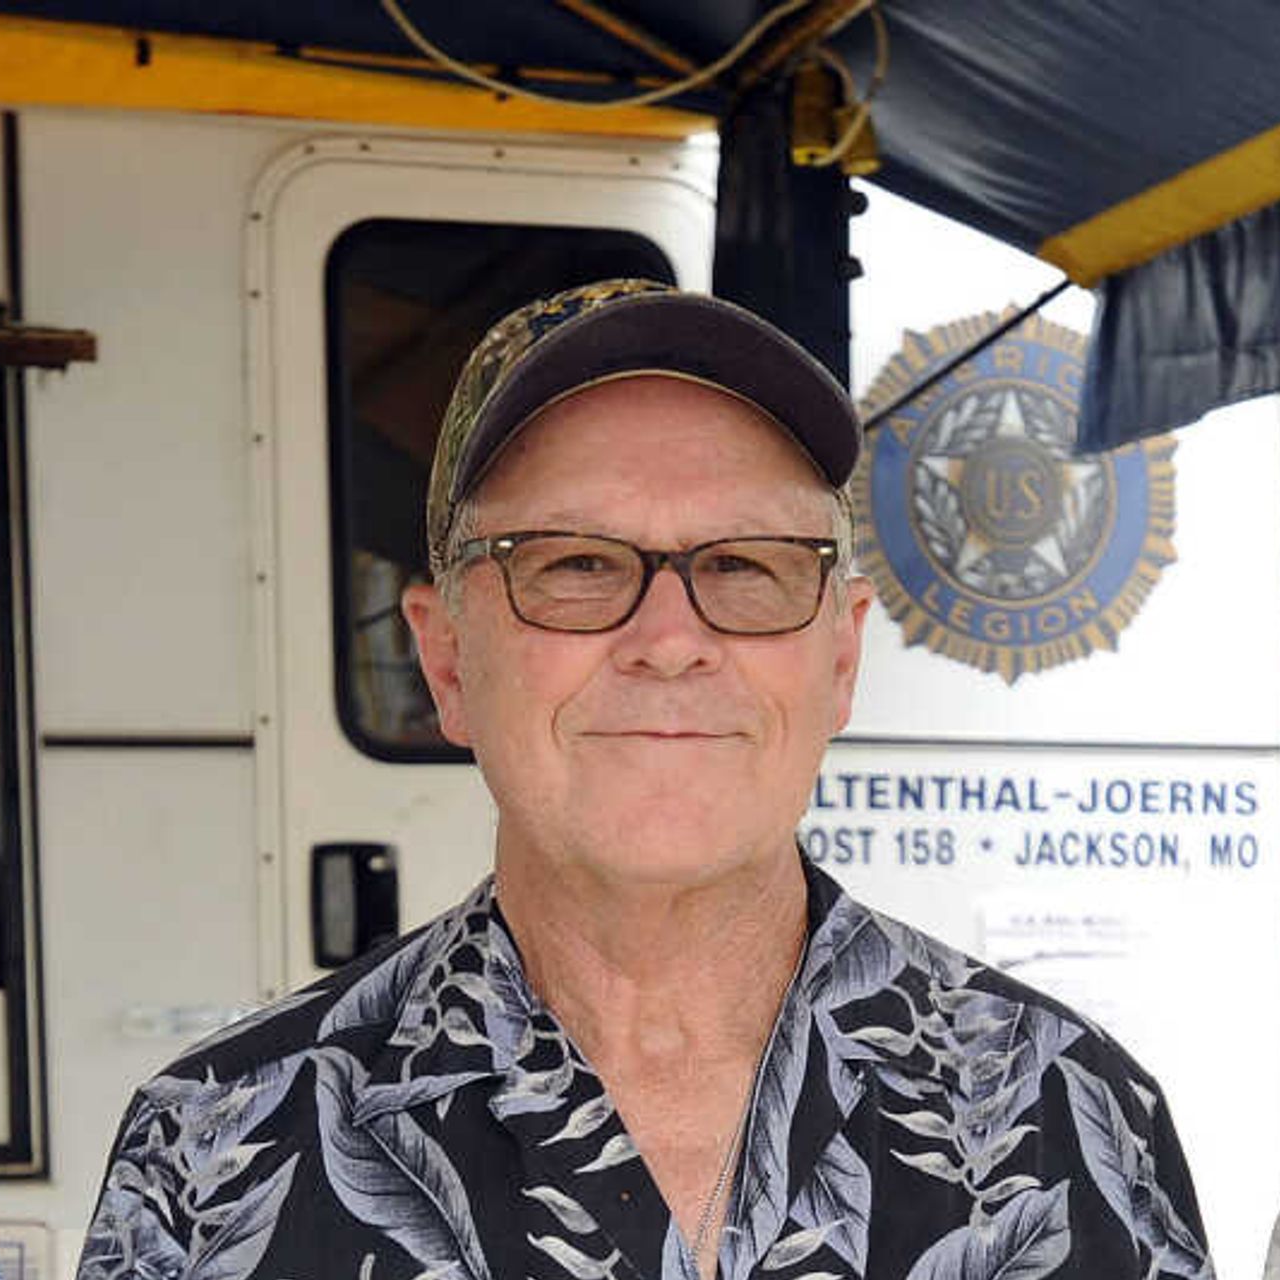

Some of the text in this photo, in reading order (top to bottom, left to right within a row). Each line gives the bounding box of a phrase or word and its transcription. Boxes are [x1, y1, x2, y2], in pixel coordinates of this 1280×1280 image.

[923, 583, 1098, 641] LEGION
[815, 774, 1259, 816] LTENTHAL-JOERNS
[807, 827, 1259, 874] OST 158 JACKSON, MO
